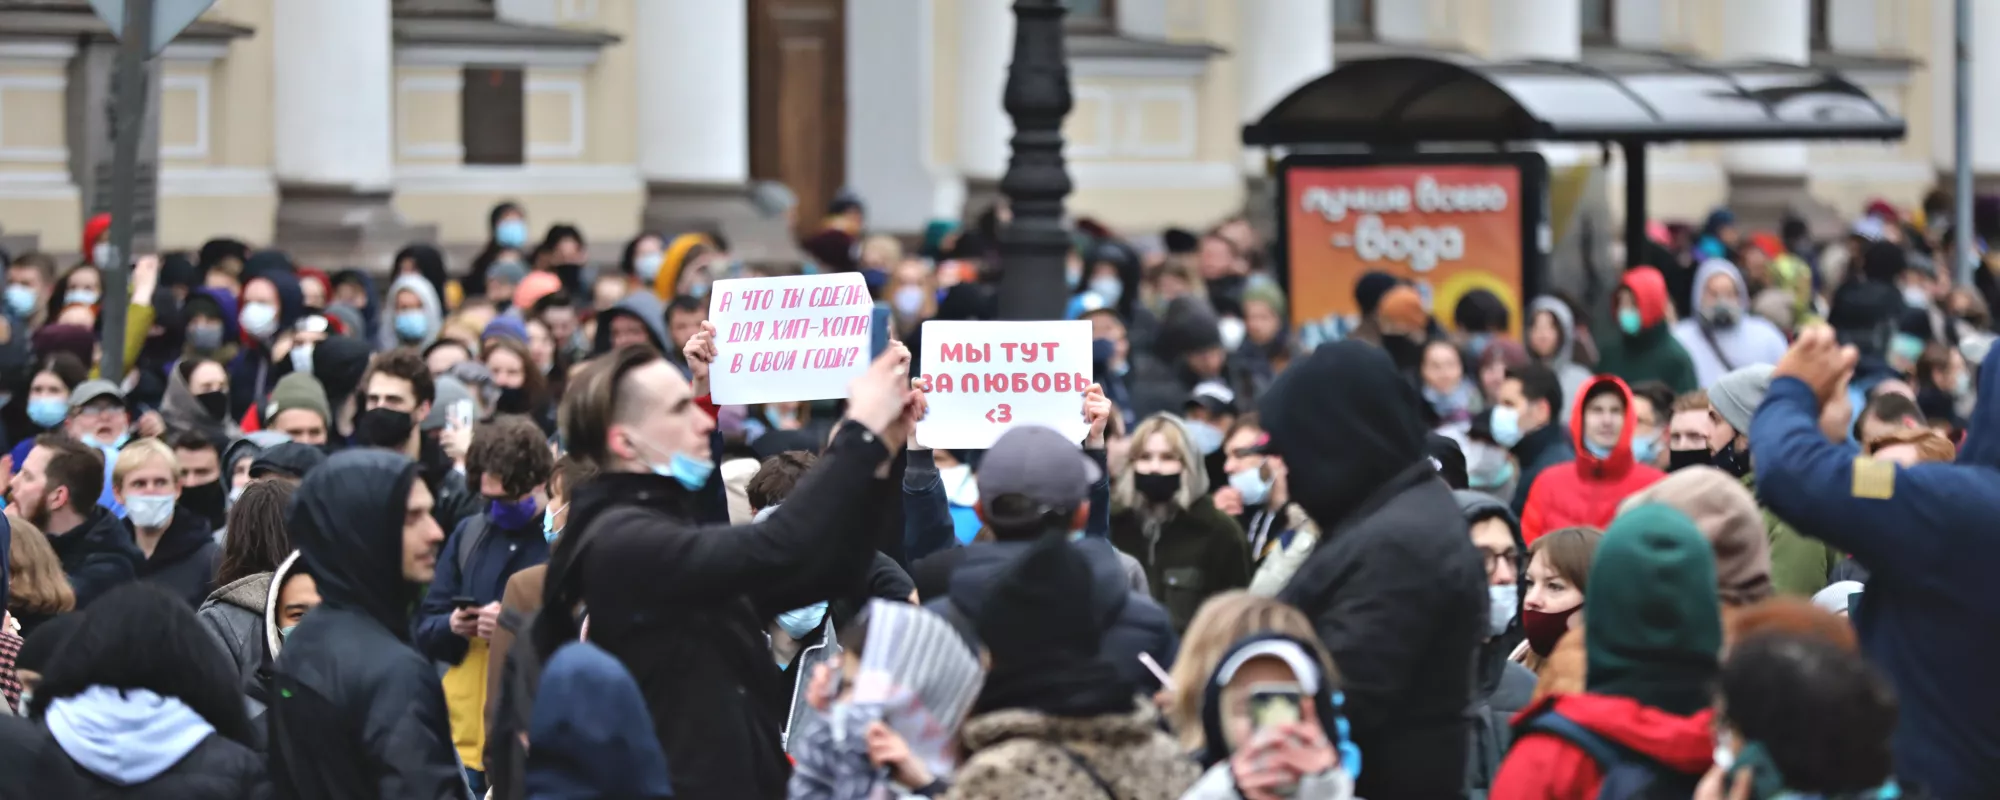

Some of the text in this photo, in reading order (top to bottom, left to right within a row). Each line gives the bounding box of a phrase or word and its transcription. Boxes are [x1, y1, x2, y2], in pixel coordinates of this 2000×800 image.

[719, 292, 732, 312] А
[742, 290, 774, 311] ЧТО
[781, 288, 804, 309] ТЫ
[726, 315, 869, 343] ДЛЯ ХИП-ХОПА
[730, 347, 859, 373] В СВОИ ГОДЫ?
[941, 342, 1060, 363] МЫ ТУТ
[922, 373, 1091, 393] ЗА ЛЮБОВЬ
